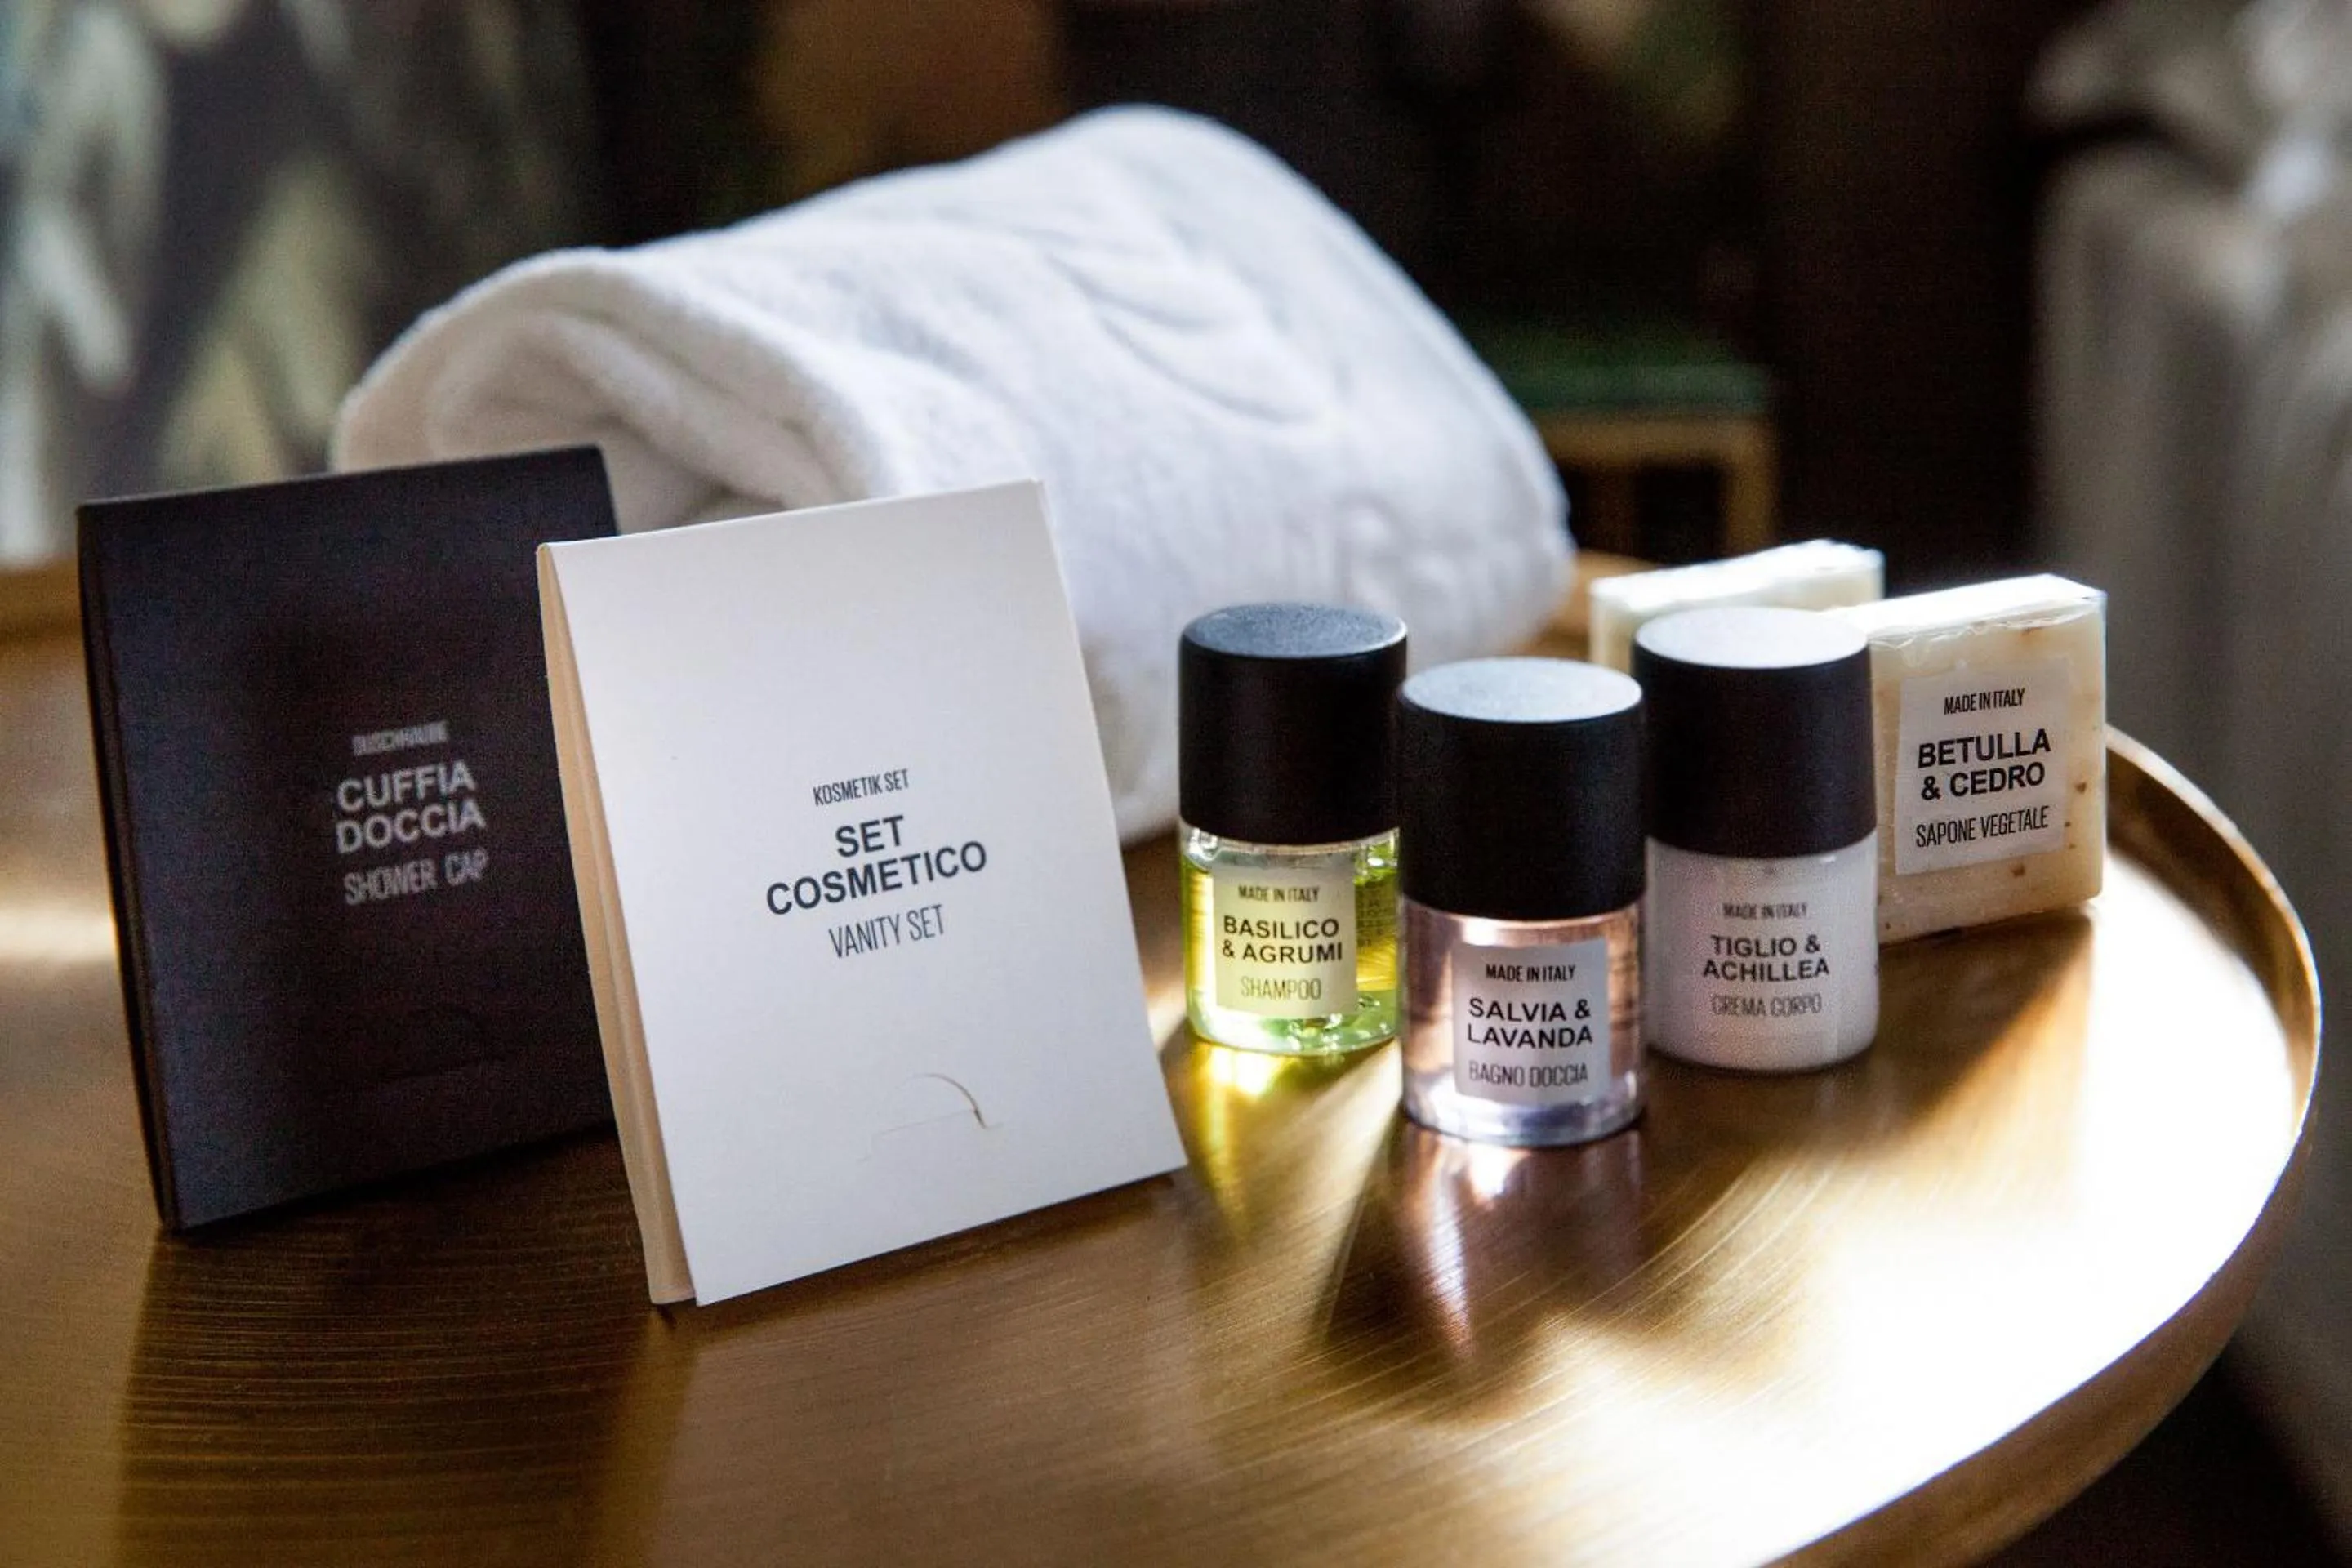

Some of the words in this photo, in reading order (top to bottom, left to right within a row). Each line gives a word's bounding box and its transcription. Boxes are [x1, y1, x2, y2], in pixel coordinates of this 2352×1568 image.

[1944, 693, 1977, 715] MADE
[1979, 691, 1992, 710] IN
[1993, 688, 2025, 709] ITALY
[1918, 728, 2051, 768] BETULLA
[337, 759, 477, 813] CUFFIA
[813, 773, 883, 806] KOSMETIK
[884, 768, 910, 792] SET
[1921, 776, 1941, 800] &
[1949, 761, 2045, 797] CEDRO
[336, 797, 487, 854] DOCCIA
[835, 815, 904, 858] SET
[1916, 817, 1976, 848] SAPONE
[1980, 805, 2050, 839] VEGETALE
[766, 840, 987, 915] COSMETICO
[1238, 884, 1270, 902] MADE
[1273, 887, 1286, 901] IN
[1288, 886, 1320, 902] ITALY
[828, 913, 901, 958] VANITY
[906, 904, 945, 941] SET
[1223, 915, 1339, 939] BASILICO
[1223, 940, 1235, 958] &
[1242, 942, 1343, 963] AGRUMI
[1711, 935, 1797, 957] TIGLIO
[1805, 934, 1820, 954] &
[1486, 964, 1523, 982] MADE
[1526, 966, 1540, 982] IN
[1542, 964, 1576, 982] ITALY
[1703, 957, 1829, 982] ACHILLEA
[1241, 976, 1321, 1000] SHAMPOO
[1469, 998, 1566, 1022] SALVIA
[1574, 999, 1591, 1020] &
[1712, 995, 1766, 1017] CREMA
[1770, 993, 1823, 1017] CORPO
[1468, 1023, 1593, 1049] LAVANDA
[1470, 1061, 1525, 1087] BAGNO
[1529, 1063, 1588, 1088] DOCCIA
